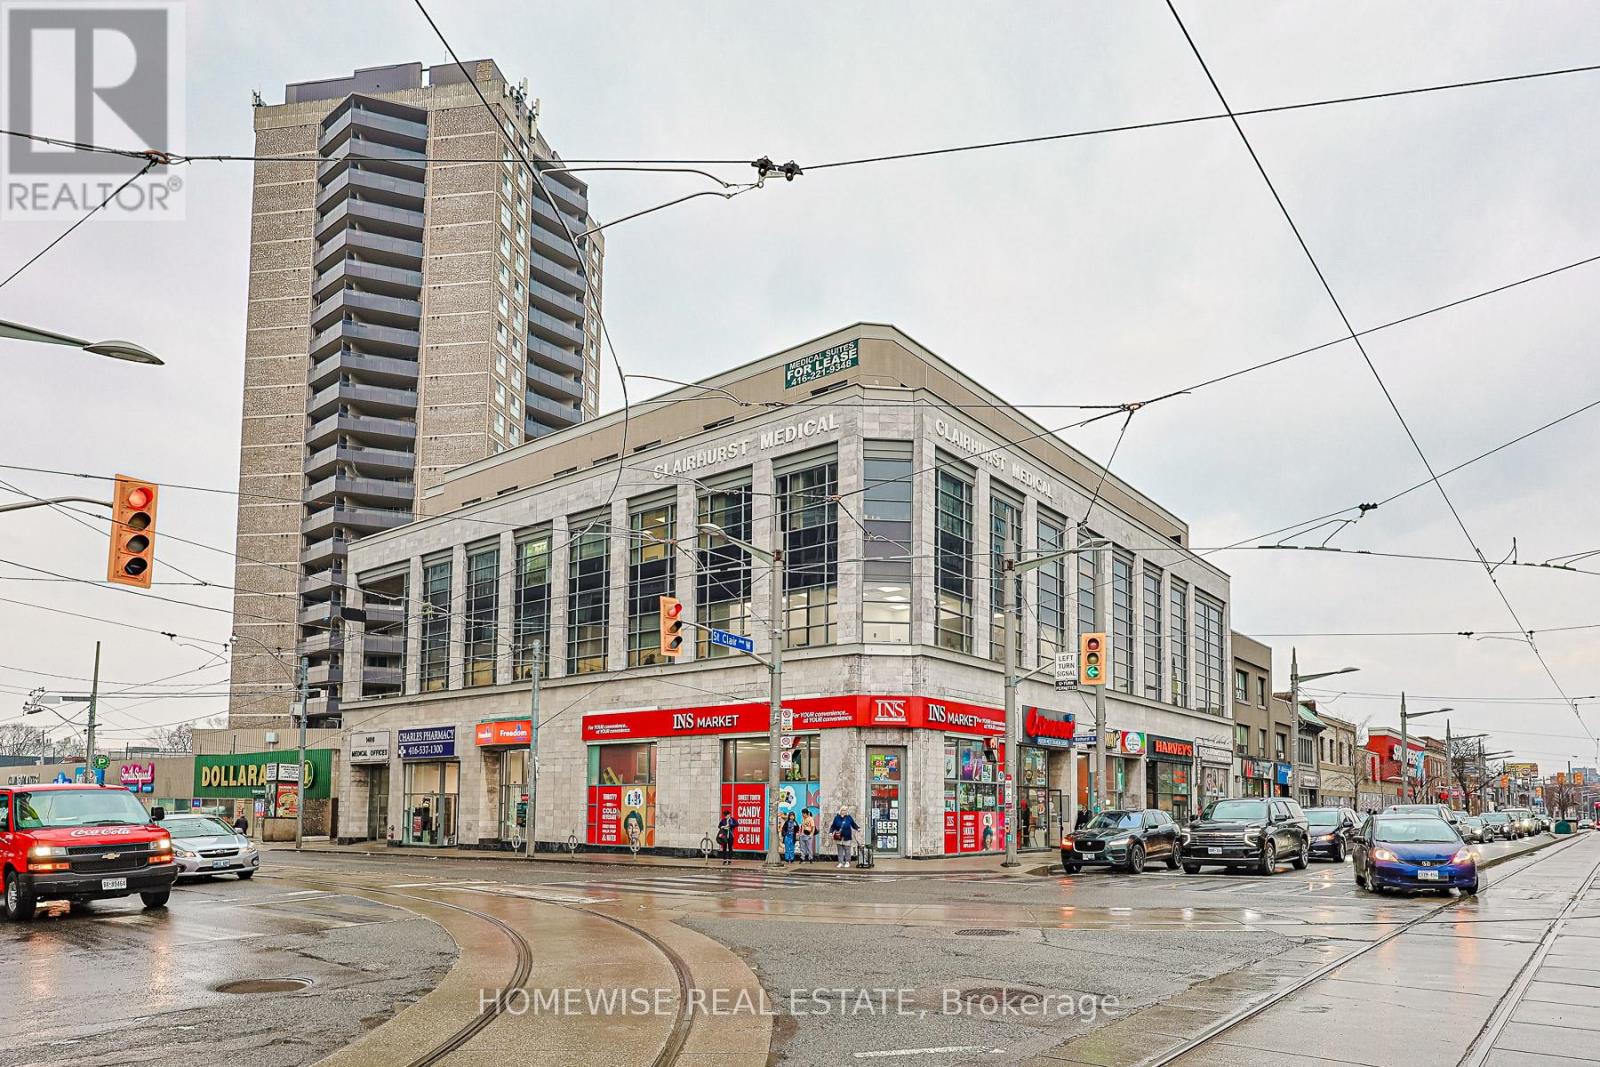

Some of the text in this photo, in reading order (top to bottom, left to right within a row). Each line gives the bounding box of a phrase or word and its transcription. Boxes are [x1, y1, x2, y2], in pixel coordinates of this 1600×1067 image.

[787, 348, 857, 380] FOR LEASE
[789, 342, 854, 370] MEDICAL SUITES
[791, 360, 851, 386] 416-221-9348
[653, 413, 840, 479] CLAIRHURST MEDICAL
[935, 419, 1053, 498] CLAIRHURST MEDICAL
[722, 634, 737, 646] Clair
[877, 701, 905, 718] INS
[928, 704, 977, 727] INS MARKET
[673, 713, 739, 730] INS MARKET
[399, 729, 454, 742] CHARLES PHARMACY
[500, 728, 527, 737] Freedom
[1155, 740, 1192, 757] HARVEY'S
[201, 764, 267, 787] DOLLARA
[738, 806, 761, 818] CANDY
[877, 821, 897, 829] BEER
[746, 834, 760, 844] GUM
